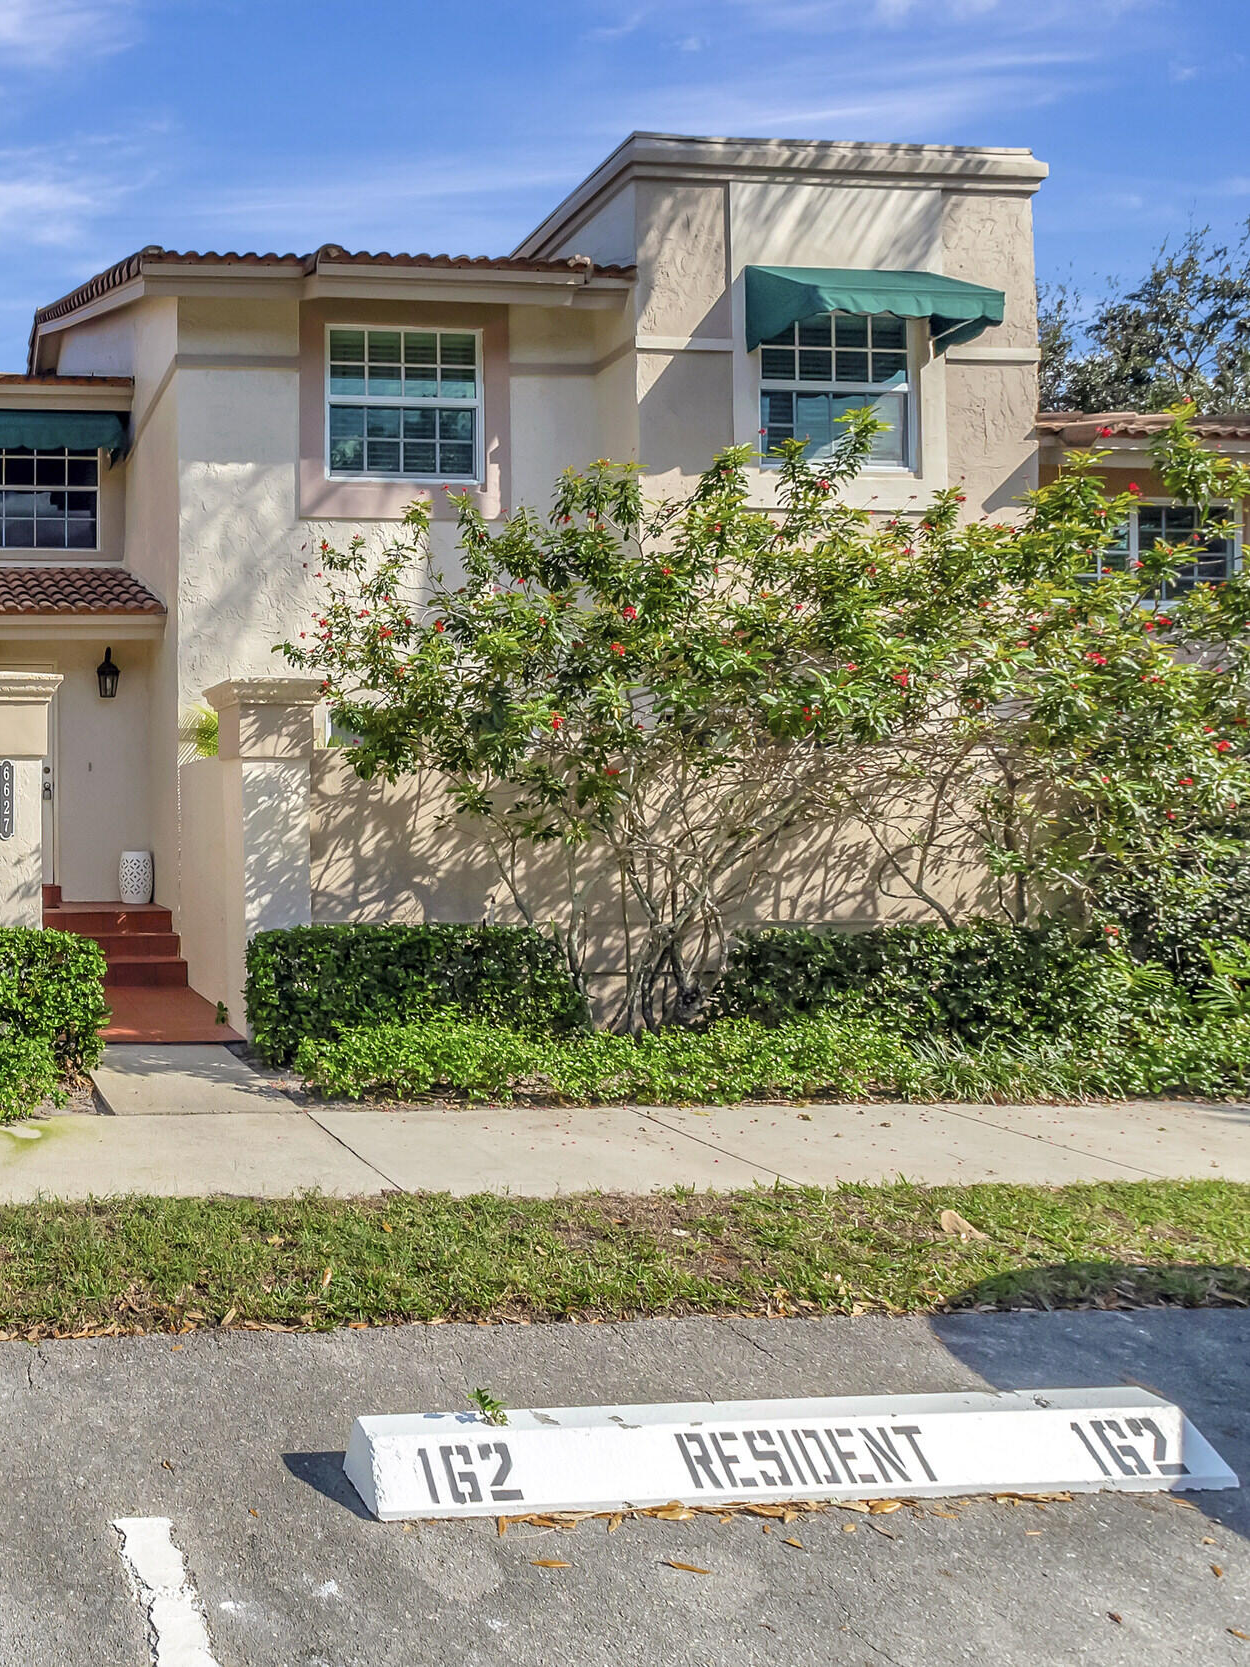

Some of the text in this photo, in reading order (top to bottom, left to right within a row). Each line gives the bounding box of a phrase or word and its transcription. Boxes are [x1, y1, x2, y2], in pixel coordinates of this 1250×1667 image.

[2, 766, 11, 833] 6627
[417, 1418, 1191, 1504] 162 RESIDENT 162
